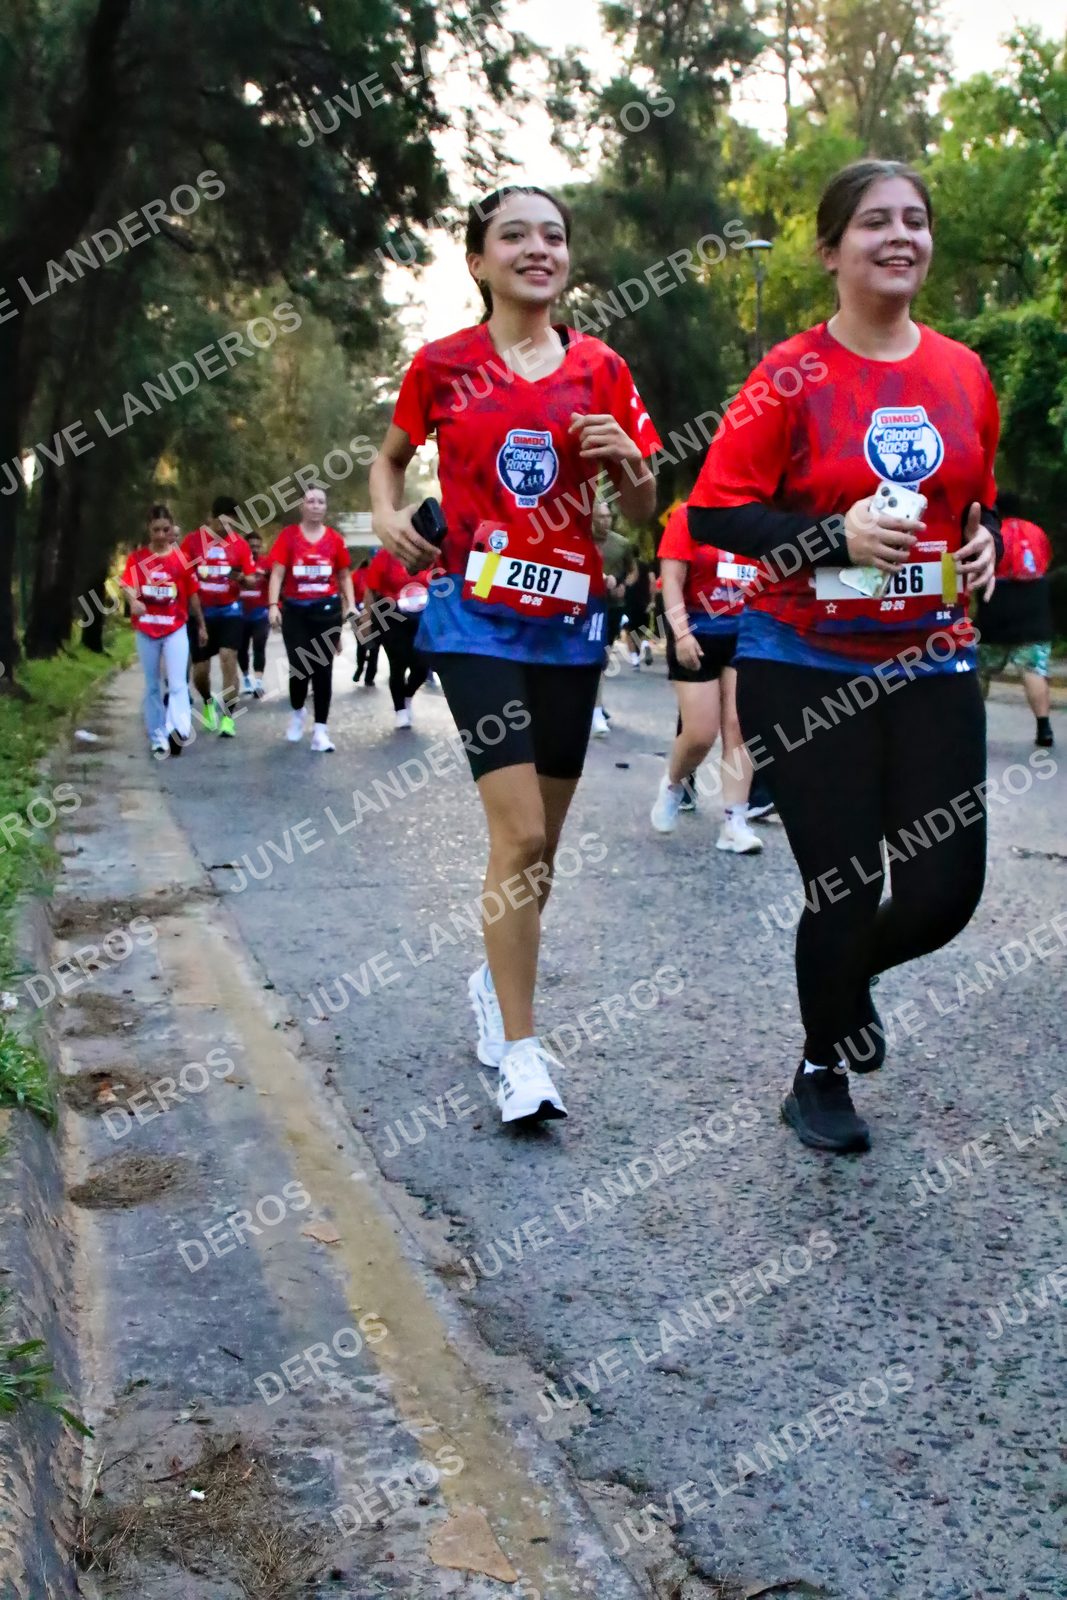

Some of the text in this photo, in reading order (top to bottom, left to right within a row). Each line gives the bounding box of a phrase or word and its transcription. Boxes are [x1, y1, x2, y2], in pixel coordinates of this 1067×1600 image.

[880, 414, 919, 424] BIMBO
[884, 428, 922, 442] Global
[877, 441, 909, 454] Race
[513, 448, 545, 461] Global
[506, 459, 532, 470] Race
[507, 561, 563, 595] 2687
[886, 565, 924, 595] 66
